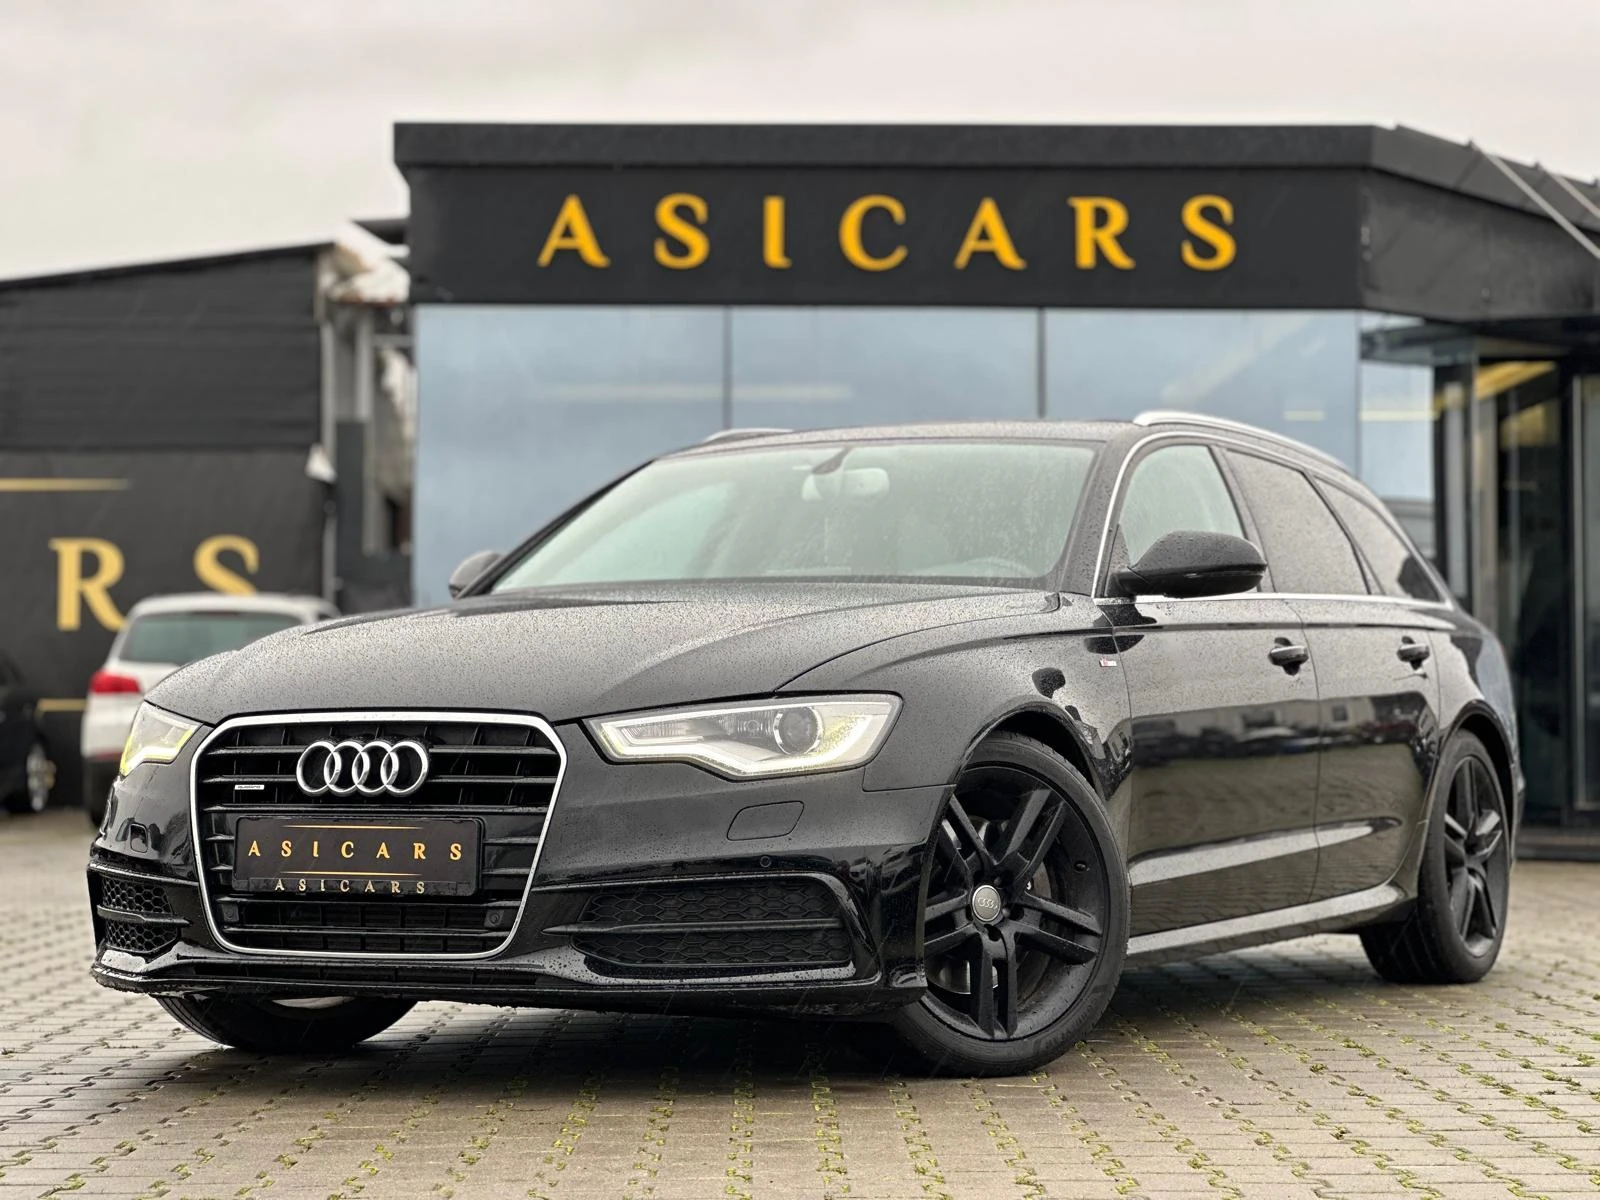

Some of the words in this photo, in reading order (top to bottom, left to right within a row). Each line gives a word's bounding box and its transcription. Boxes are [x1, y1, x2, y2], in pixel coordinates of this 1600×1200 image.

[537, 194, 1237, 271] ASICARS
[248, 840, 462, 860] ASICARS
[275, 878, 425, 894] ASICARS
